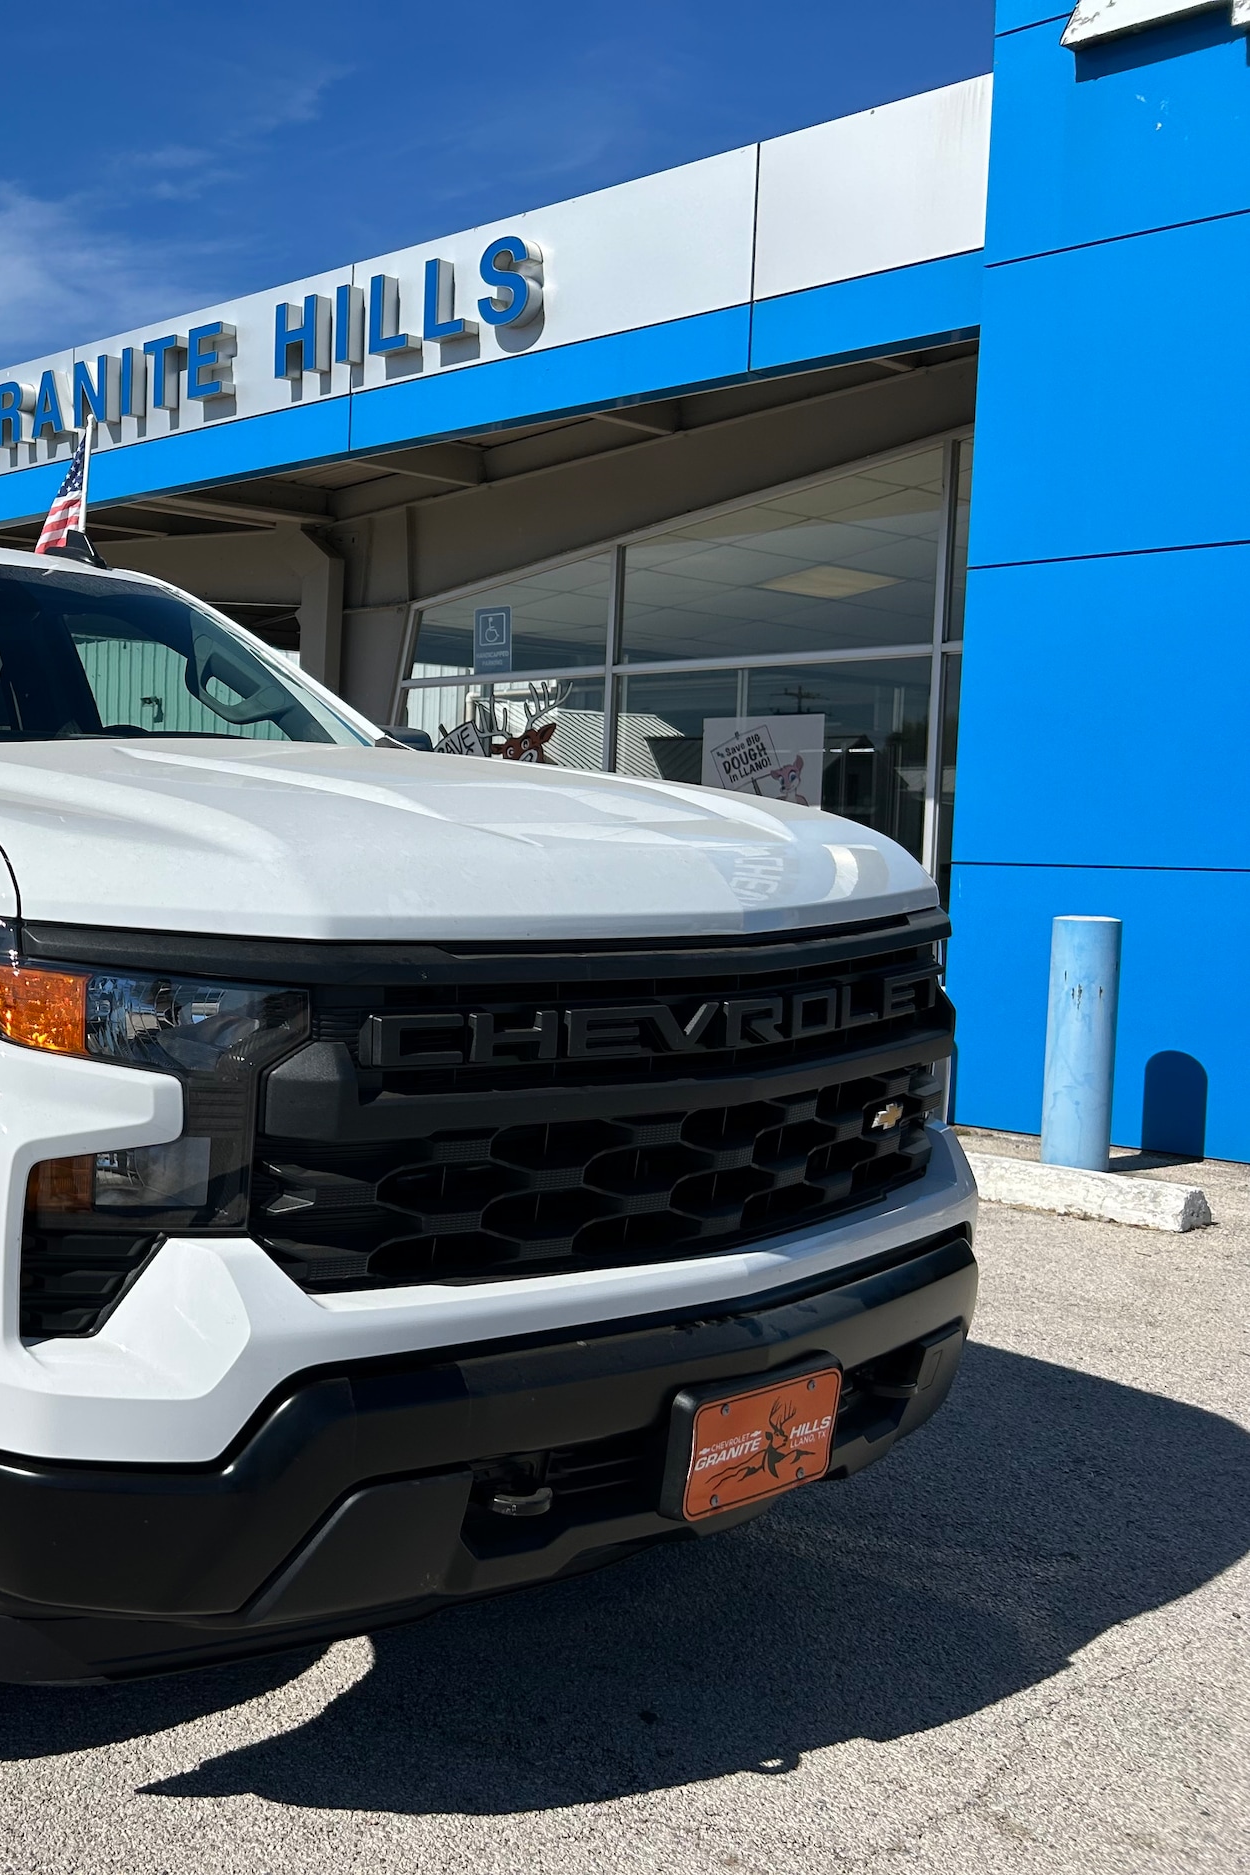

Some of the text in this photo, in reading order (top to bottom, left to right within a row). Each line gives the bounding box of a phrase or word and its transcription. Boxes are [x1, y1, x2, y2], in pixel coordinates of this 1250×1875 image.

[274, 236, 542, 381] HILLS
[722, 742, 768, 775] DOUGH
[725, 742, 745, 756] Save
[738, 756, 771, 778] LLANO!
[368, 965, 946, 1068] CHEVROLET
[694, 1415, 832, 1472] GRANITE HILLS
[711, 1433, 751, 1453] CHEVROLET
[789, 1430, 827, 1449] LLANO, TX
